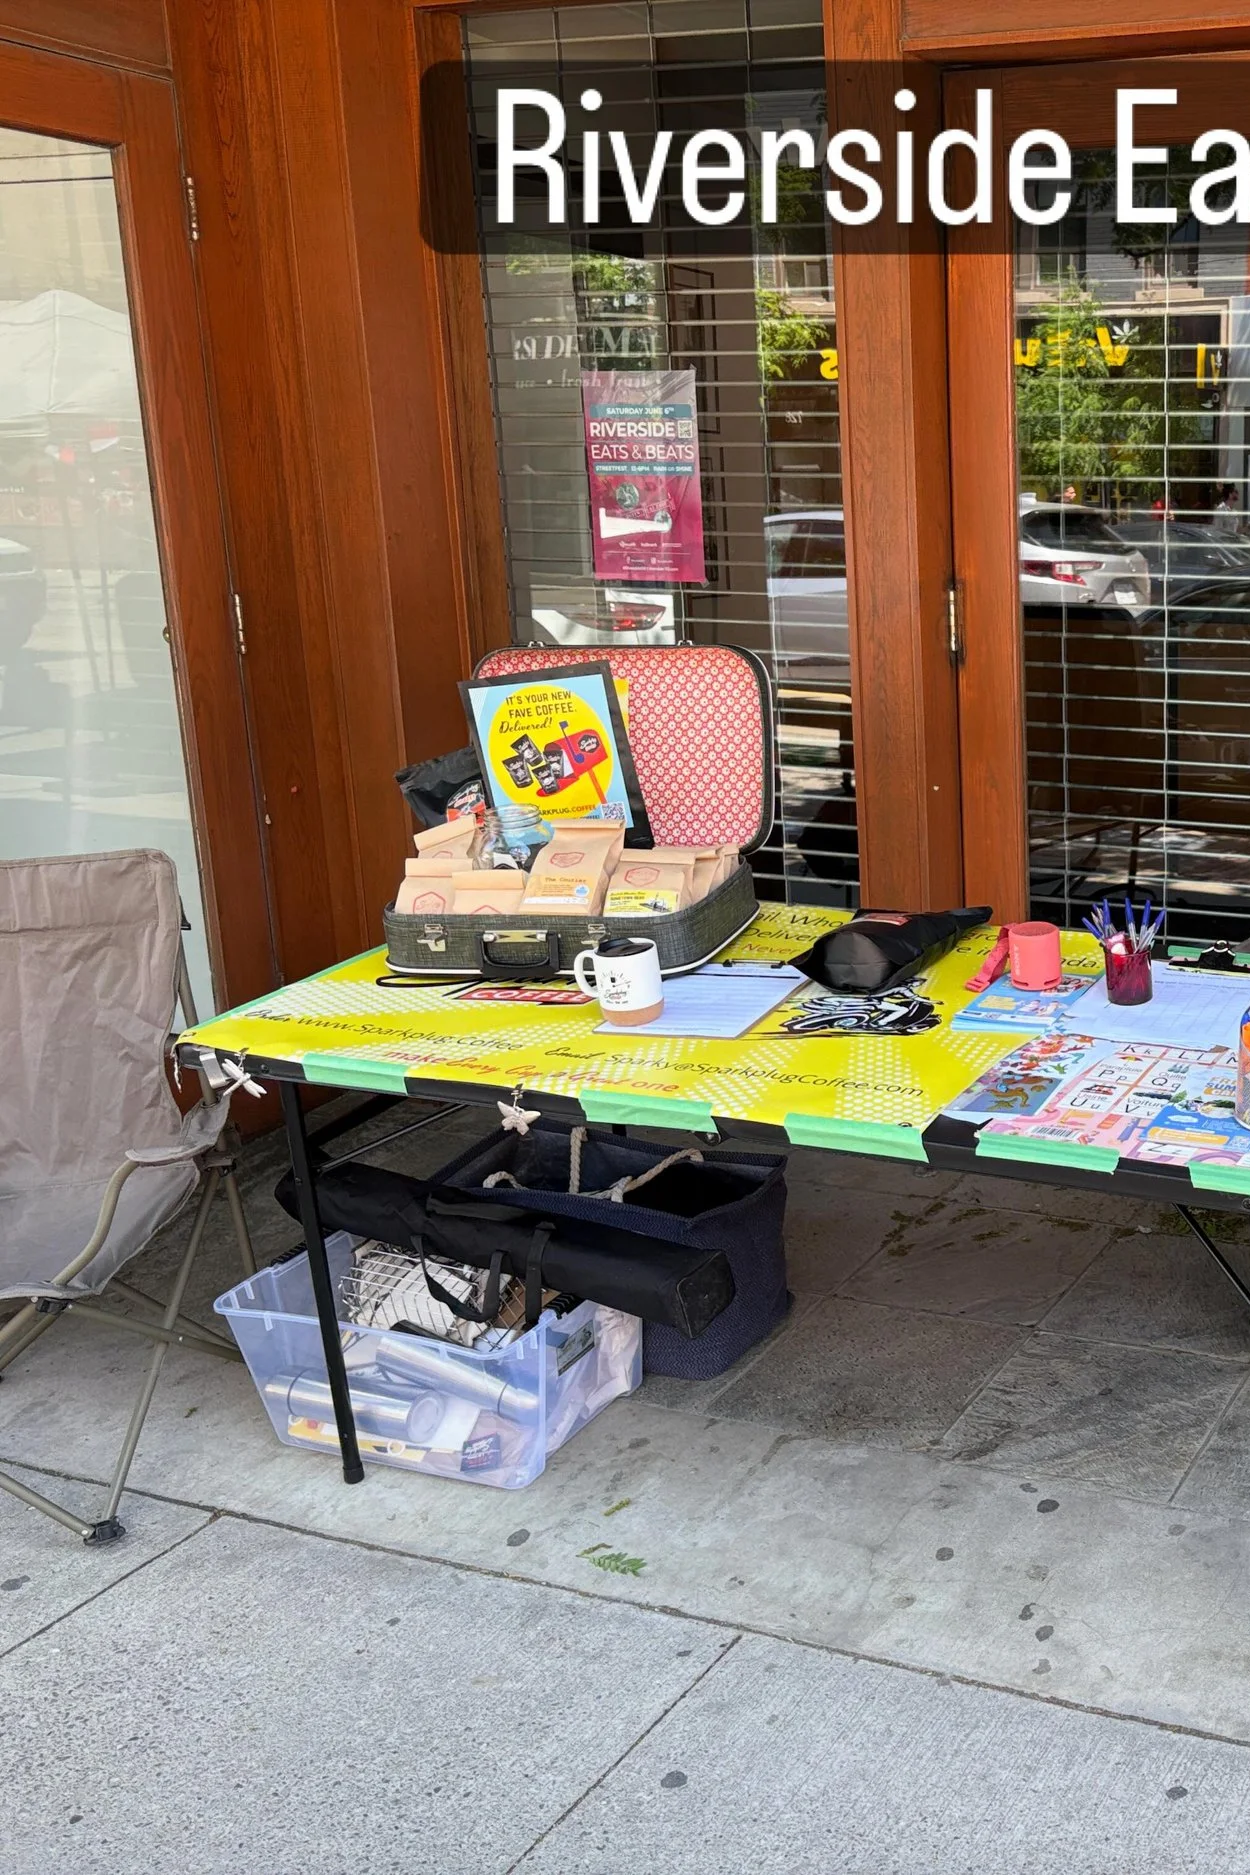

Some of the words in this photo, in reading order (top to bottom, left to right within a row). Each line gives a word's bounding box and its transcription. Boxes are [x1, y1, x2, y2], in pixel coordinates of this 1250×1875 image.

[606, 407, 643, 415] SATURDAY
[644, 407, 663, 415] JUNE
[590, 422, 675, 438] RIVERSIDE
[591, 445, 629, 459] EATS
[631, 445, 642, 459] &
[645, 445, 695, 459] BEATS
[506, 694, 523, 705] IT'S
[525, 692, 549, 704] YOUR
[551, 690, 572, 700] NEW
[509, 707, 533, 719] FAVE
[535, 702, 577, 716] COFFEE.
[500, 717, 553, 734] Delivered!
[790, 914, 845, 928] Who
[741, 943, 798, 955] Never
[1013, 943, 1021, 976] SONY
[471, 989, 588, 1002] COFFEE
[297, 1017, 524, 1051] www.Sparkplug.Coffee
[383, 1050, 447, 1064] make
[446, 1057, 501, 1075] Every
[631, 1080, 680, 1093] one
[545, 1046, 606, 1060] Email
[604, 1053, 924, 1097] Sparky@SparkplugCoffee.com
[1097, 1069, 1115, 1078] P
[1151, 1077, 1168, 1086] Q
[1070, 1096, 1092, 1108] U
